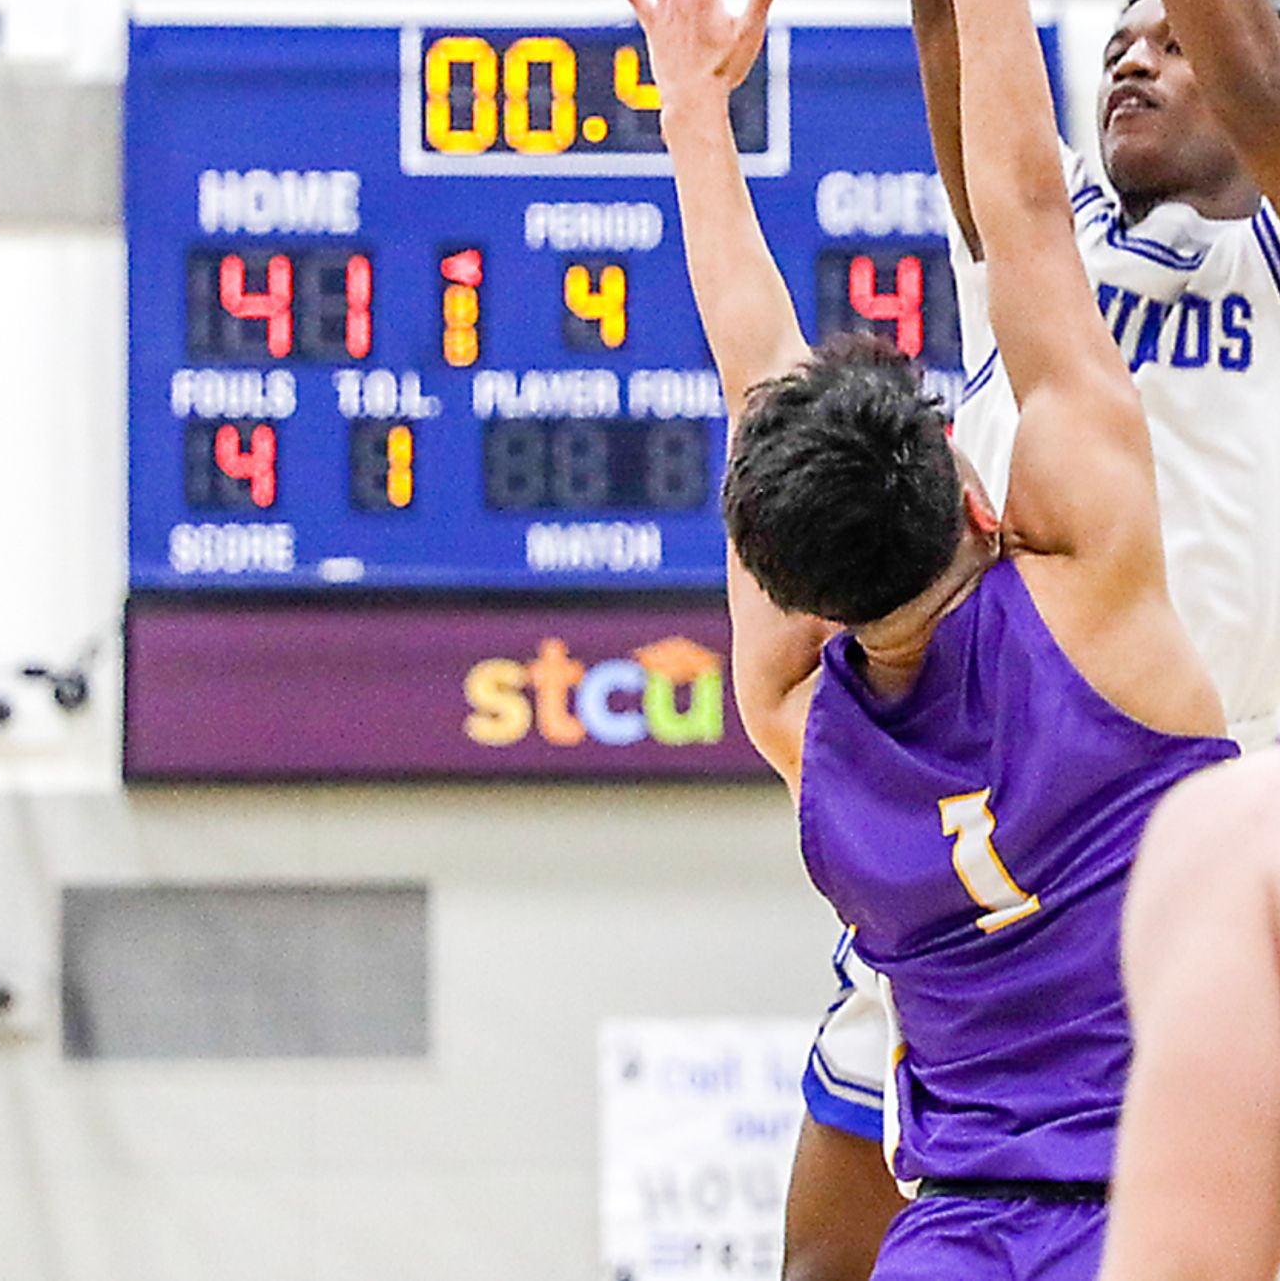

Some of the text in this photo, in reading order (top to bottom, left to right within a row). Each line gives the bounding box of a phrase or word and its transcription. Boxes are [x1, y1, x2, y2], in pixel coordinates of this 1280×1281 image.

[198, 169, 361, 234] HOME
[525, 202, 662, 251] PERIOD
[816, 170, 948, 236] GUES
[220, 256, 371, 358] 41
[564, 266, 627, 358] 4
[849, 257, 923, 358] 4
[171, 369, 297, 419] FOULS
[473, 369, 728, 419] PLAYER FOUL
[215, 425, 276, 507] 4
[387, 426, 413, 507] 1
[170, 523, 296, 574] SCORE
[526, 522, 662, 571] MATCH
[464, 637, 723, 746] stcu
[938, 787, 1041, 933] 1
